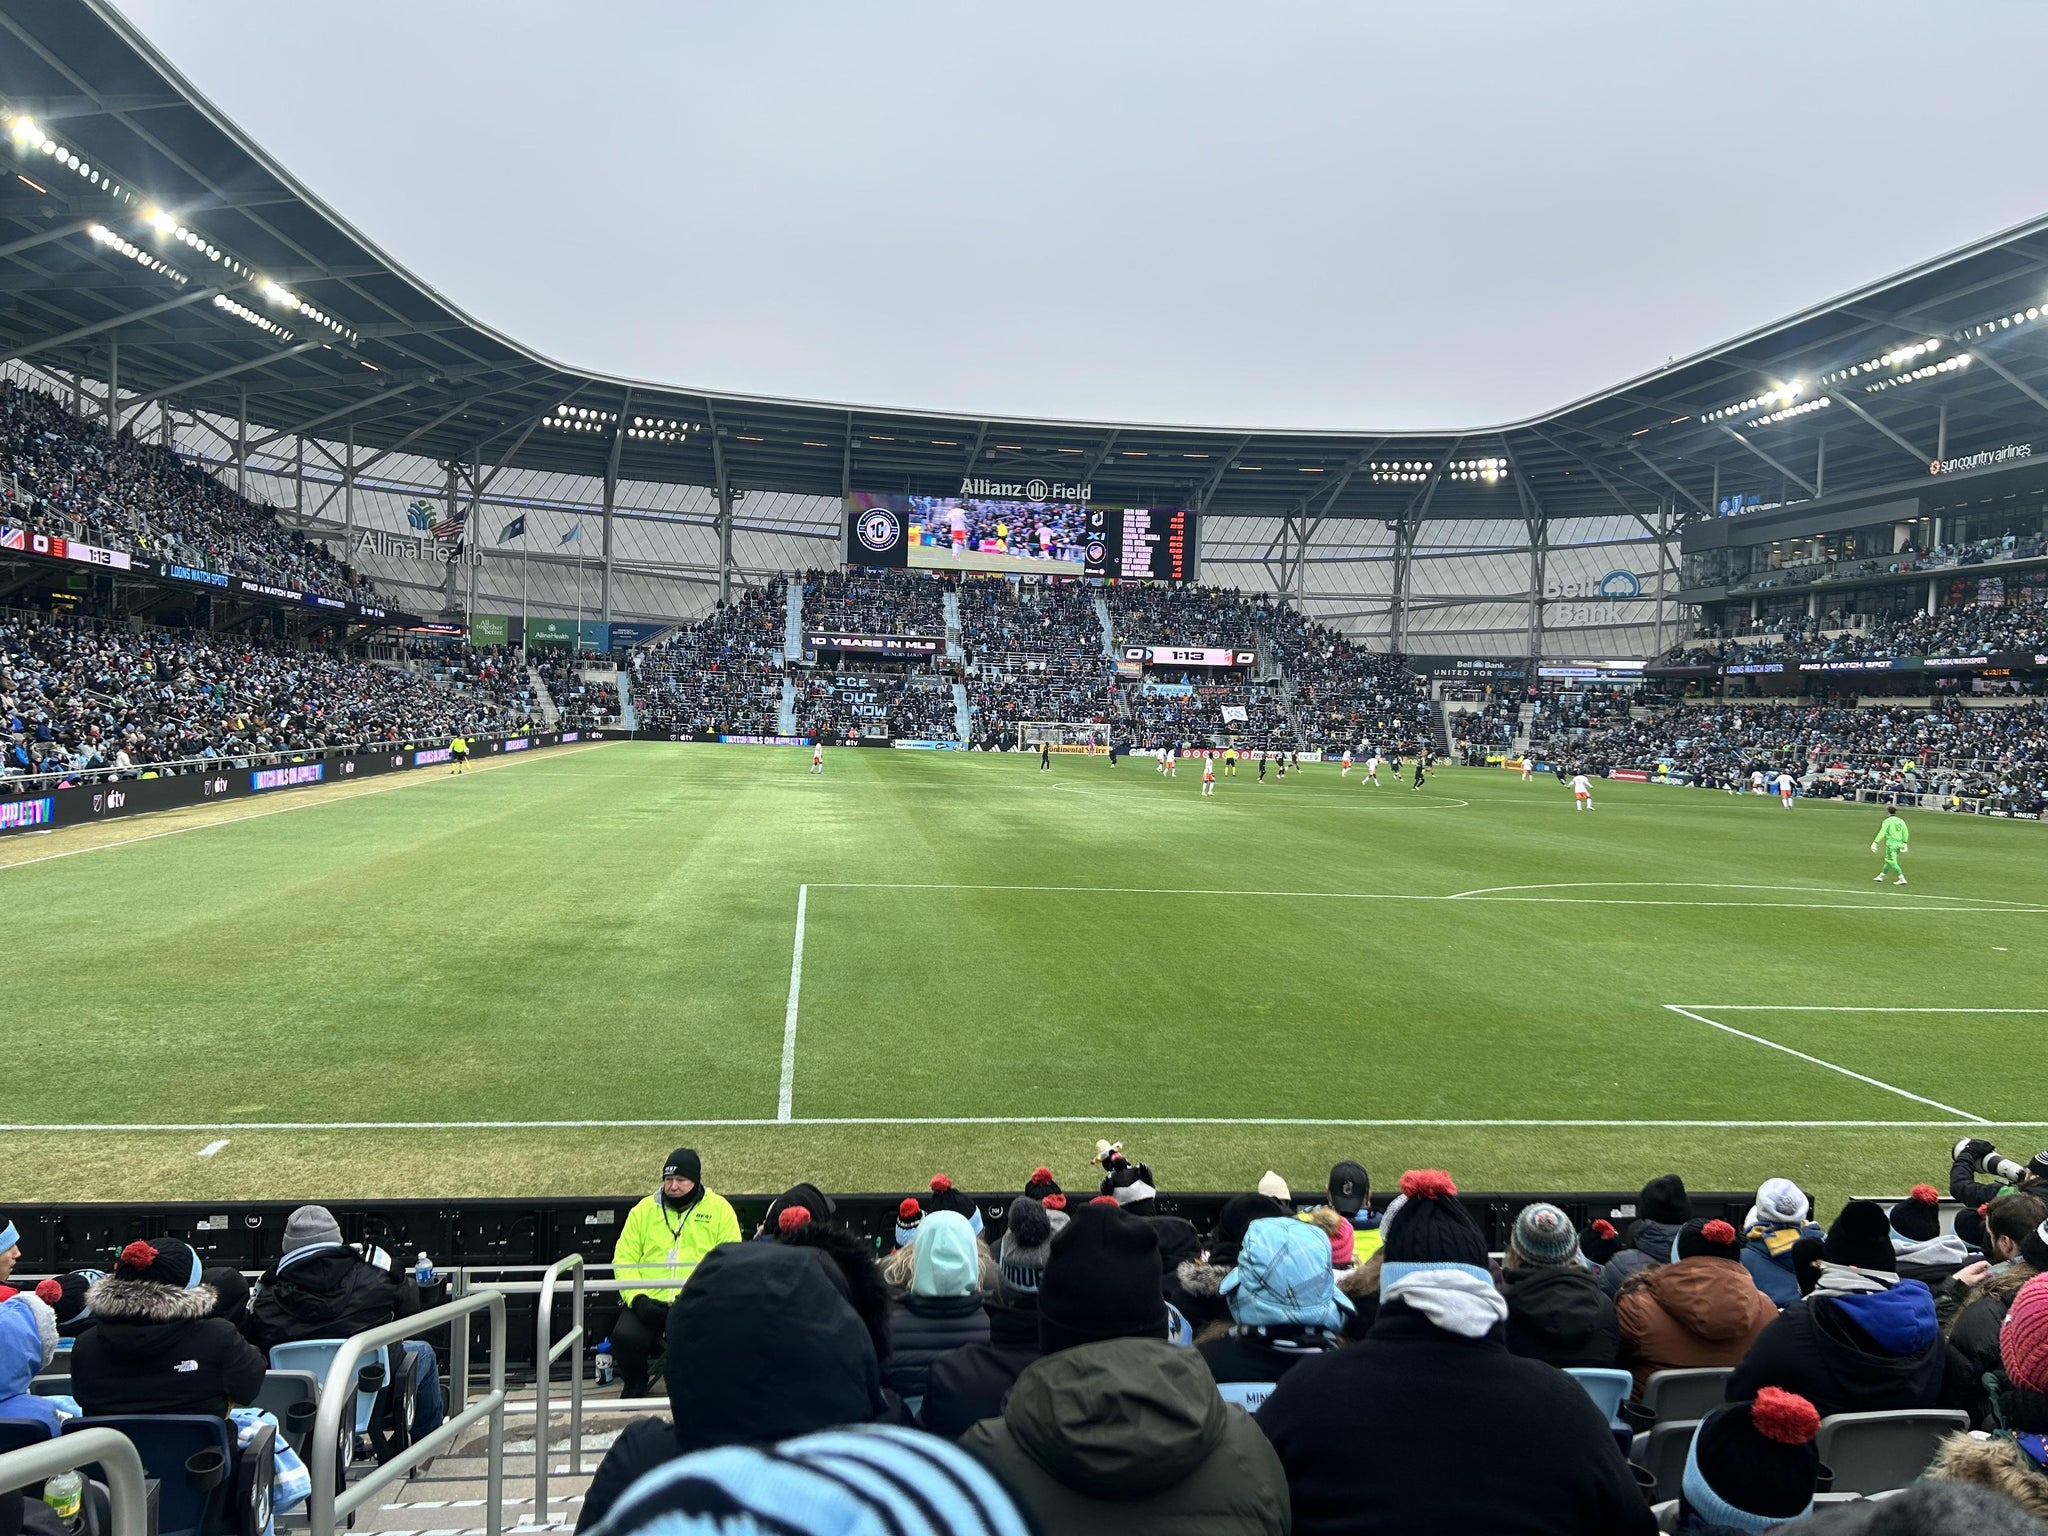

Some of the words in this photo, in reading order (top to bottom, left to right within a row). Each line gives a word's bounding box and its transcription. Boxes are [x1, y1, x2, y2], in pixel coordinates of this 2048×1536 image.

[960, 478, 1022, 496] Allianz
[1052, 483, 1091, 500] Field
[1086, 531, 1106, 540] XI
[33, 534, 49, 553] 0
[89, 549, 111, 564] 1:13
[191, 568, 211, 584] WATCH
[241, 581, 258, 592] FIND
[264, 585, 286, 597] WATCH
[286, 591, 303, 600] SPOT
[1543, 576, 1595, 598] Bell
[1556, 601, 1623, 623] Bank
[810, 637, 827, 645] 10
[830, 637, 884, 648] YEARS
[886, 640, 901, 649] IN
[905, 641, 936, 650] MLS
[1125, 648, 1144, 660] 0
[1172, 651, 1204, 661] 1:13
[1236, 652, 1254, 664] 0
[1484, 661, 1505, 669] Bank
[1744, 664, 1764, 673] WATCH
[1764, 664, 1783, 672] SPOTS
[1799, 663, 1820, 671] FIND
[1829, 661, 1864, 669] WATCH
[842, 692, 877, 703] OUT
[851, 705, 887, 717] NOW
[764, 736, 774, 744] ON
[1048, 746, 1085, 754] ontinental
[2013, 811, 2039, 820] MNUFC
